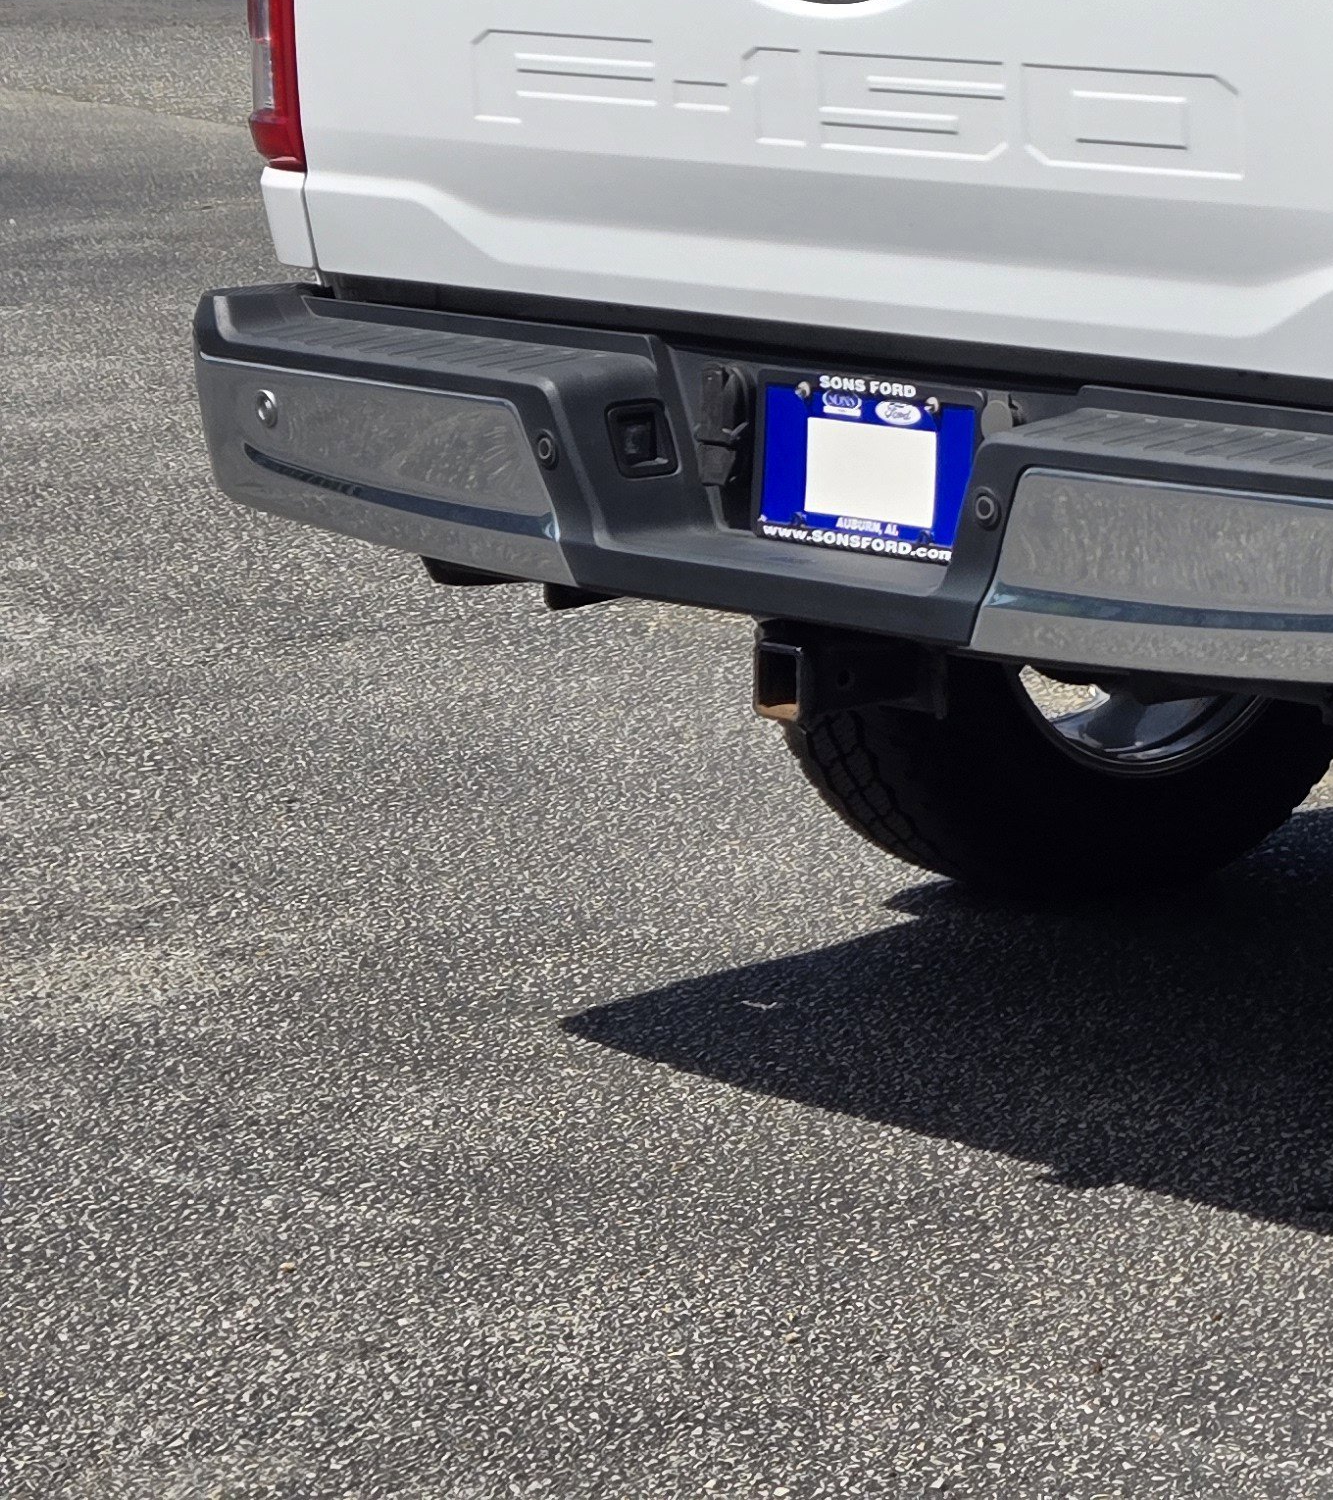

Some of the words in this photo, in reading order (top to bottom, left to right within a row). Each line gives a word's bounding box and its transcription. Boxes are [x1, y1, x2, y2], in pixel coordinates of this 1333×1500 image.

[471, 27, 1245, 181] F-150
[819, 375, 866, 393] SONS
[869, 381, 917, 398] FORD
